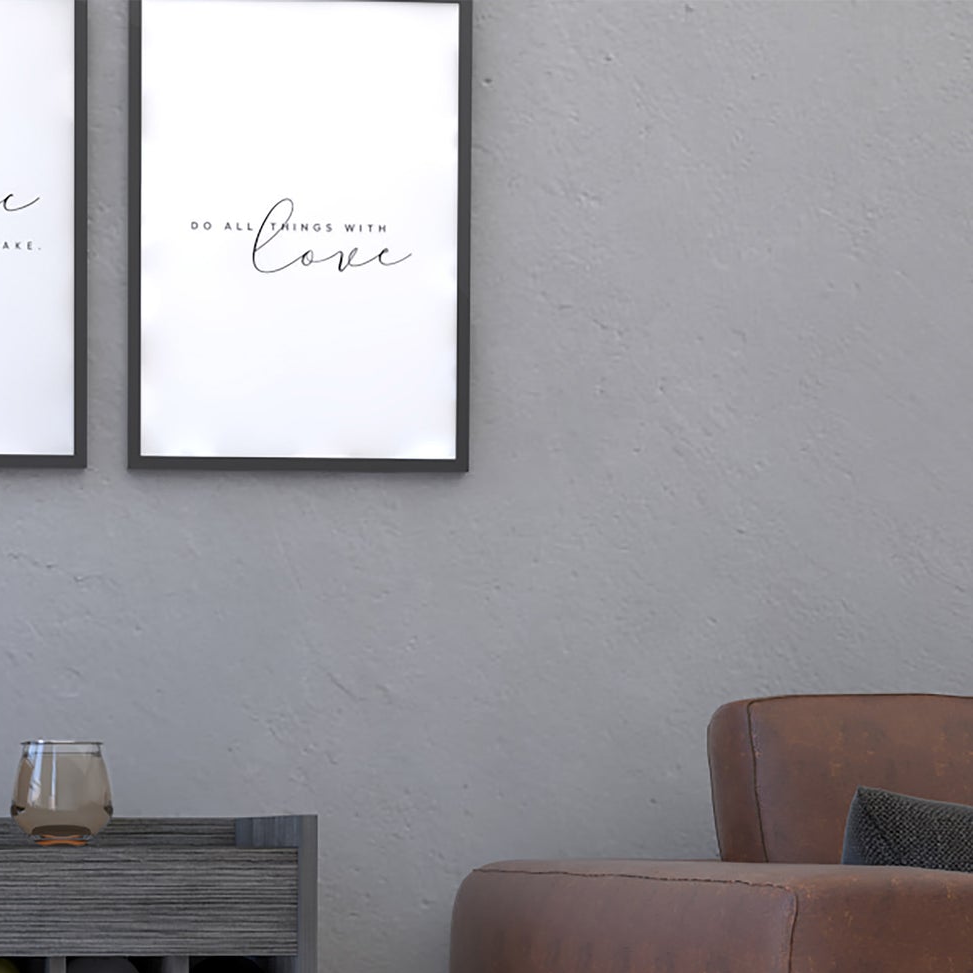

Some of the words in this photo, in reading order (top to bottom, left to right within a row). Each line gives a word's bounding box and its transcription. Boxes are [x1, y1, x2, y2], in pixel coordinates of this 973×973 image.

[190, 221, 212, 231] DO
[224, 222, 254, 231] ALL
[270, 222, 333, 232] THINGS
[344, 224, 387, 233] WITH
